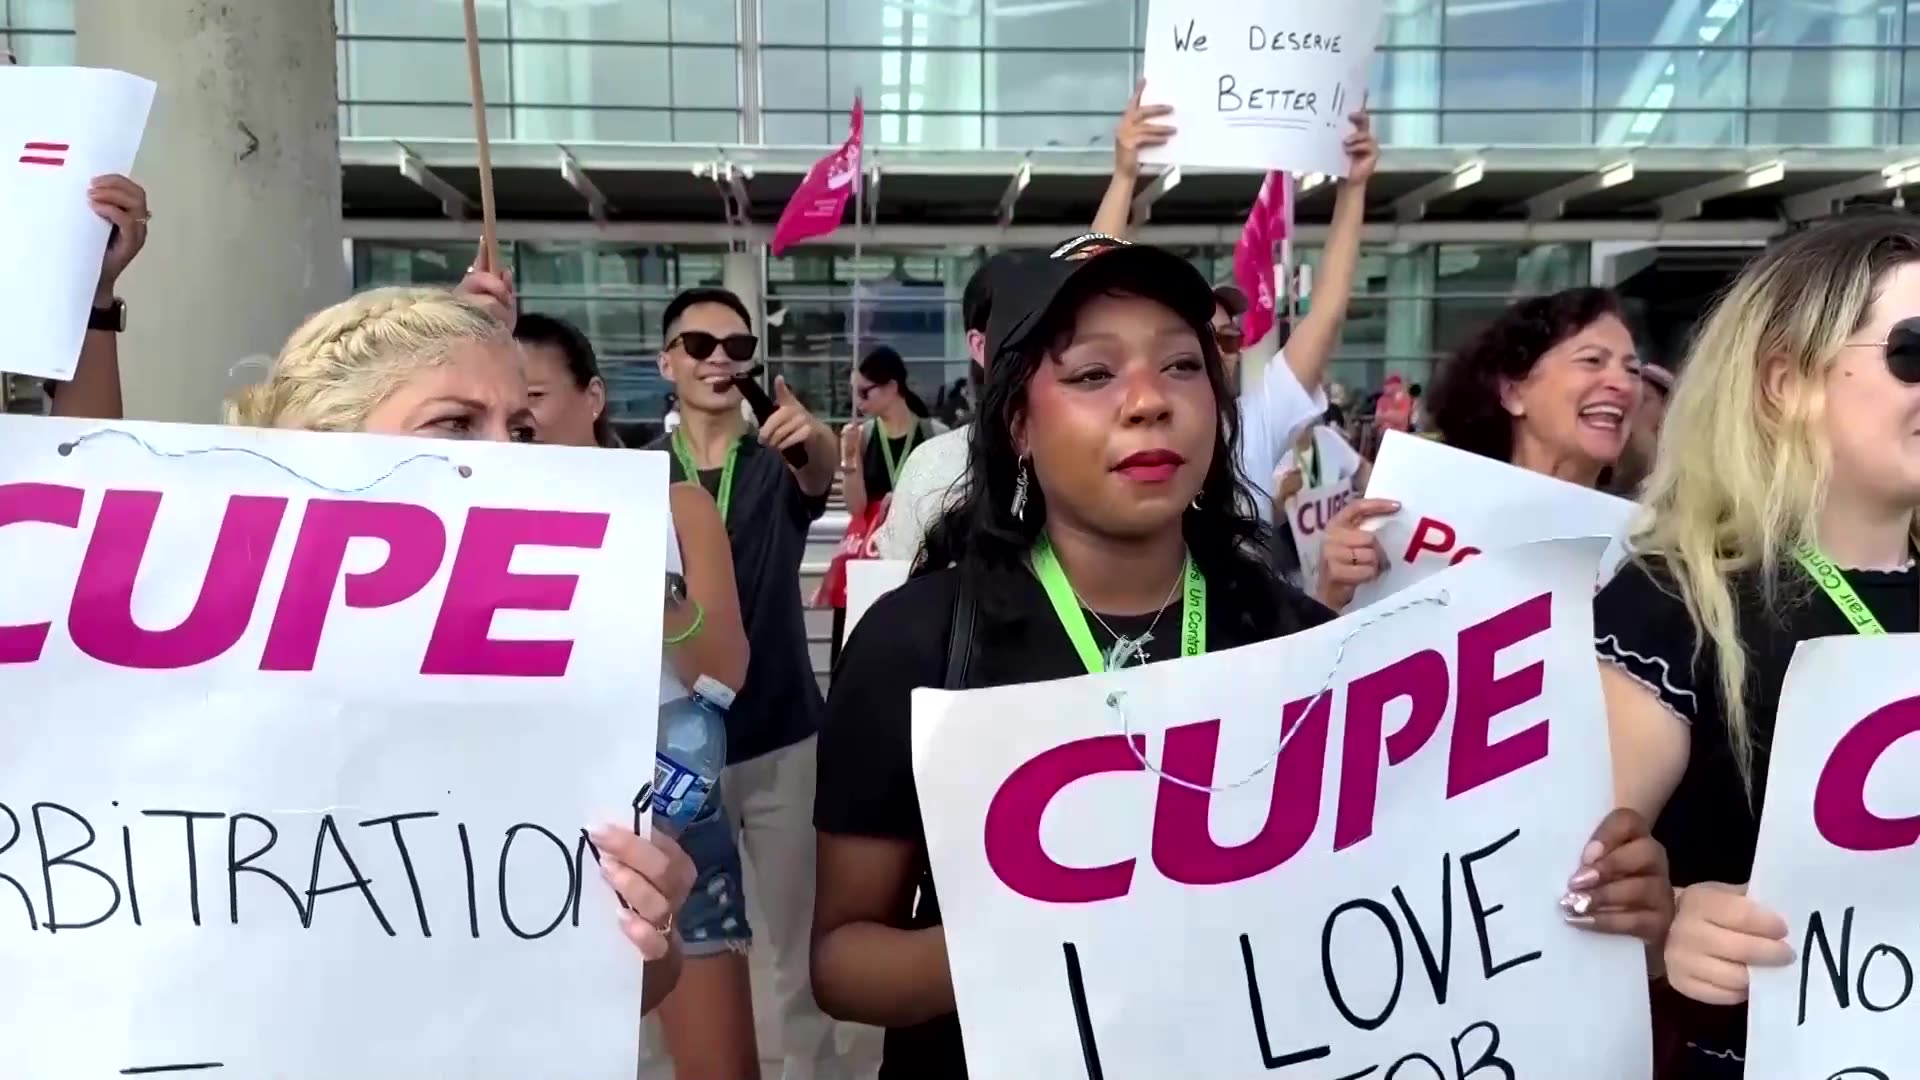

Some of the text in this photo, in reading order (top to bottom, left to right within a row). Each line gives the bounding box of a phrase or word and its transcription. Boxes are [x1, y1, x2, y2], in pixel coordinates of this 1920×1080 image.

[1173, 18, 1342, 53] We DESERVE
[985, 594, 1552, 905] CUPE
[1239, 829, 1542, 1070] LOVE
